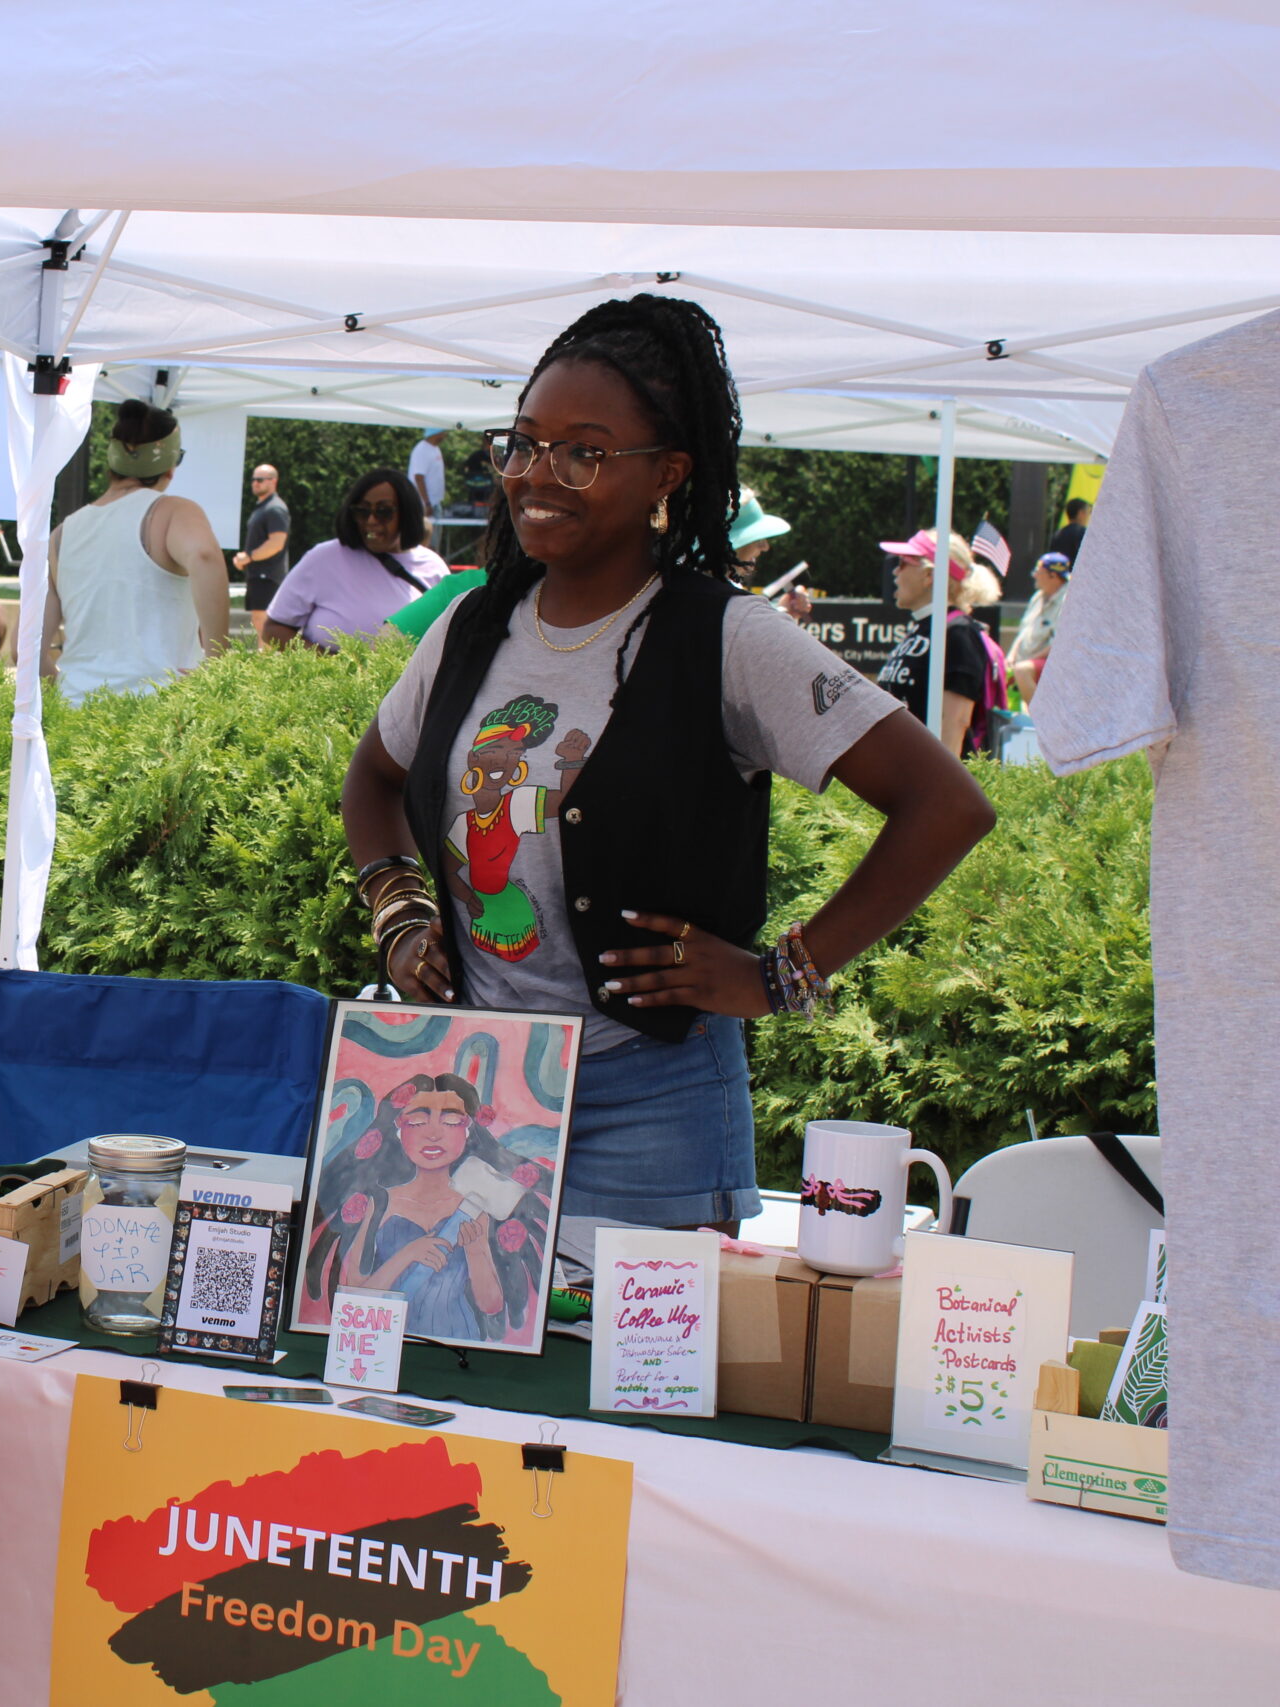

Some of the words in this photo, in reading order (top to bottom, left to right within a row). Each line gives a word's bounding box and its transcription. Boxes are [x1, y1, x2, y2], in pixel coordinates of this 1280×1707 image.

[486, 700, 556, 737] CELEBRATE
[192, 1189, 252, 1208] venmo
[84, 1217, 161, 1244] DONATE
[229, 1228, 252, 1237] Studio
[94, 1263, 150, 1284] JAR
[622, 1277, 686, 1301] Ceramic
[936, 1287, 1018, 1317] Botanical
[202, 1316, 236, 1327] venmo
[340, 1304, 392, 1331] SCAN
[617, 1307, 665, 1329] Coffee
[934, 1318, 1012, 1344] Activists
[339, 1333, 376, 1356] ME
[942, 1348, 1017, 1372] Postcards
[617, 1368, 651, 1383] Perfect
[1043, 1462, 1128, 1491] Clementines
[159, 1506, 503, 1603] JUNETEENTH
[179, 1581, 376, 1652] Freedom
[392, 1619, 481, 1679] Day
